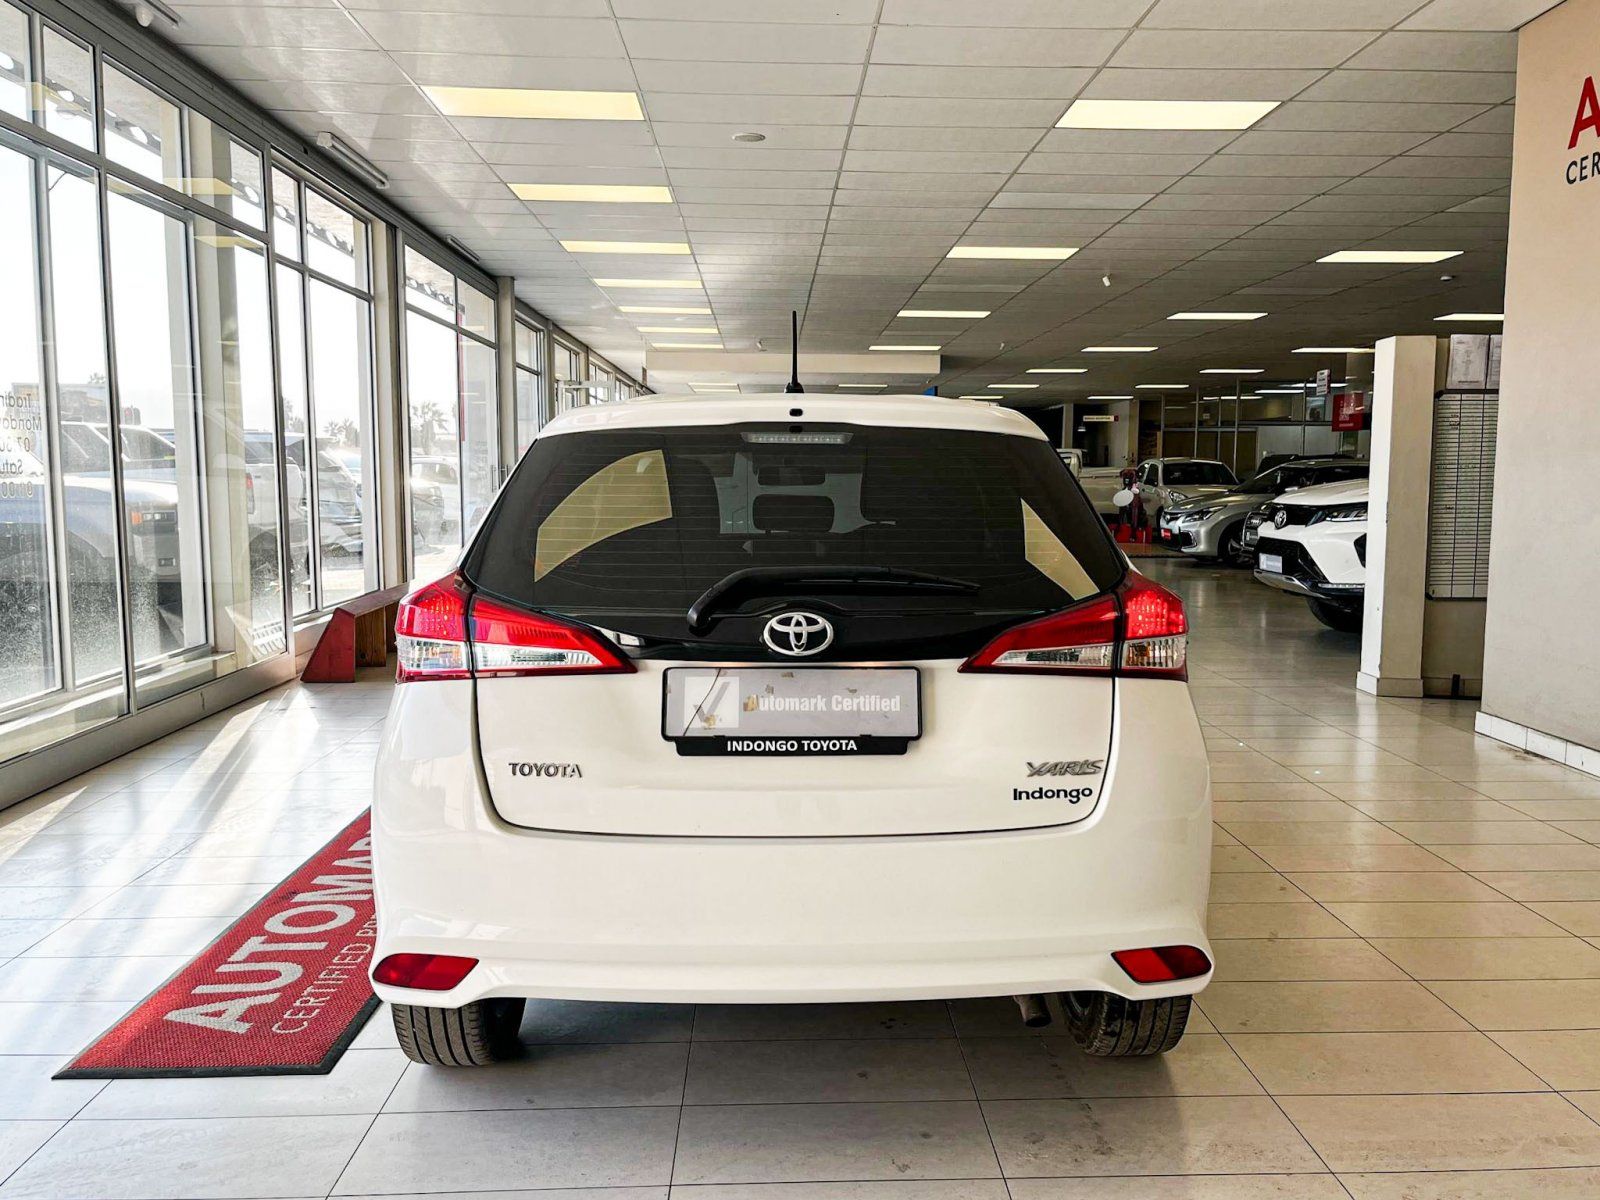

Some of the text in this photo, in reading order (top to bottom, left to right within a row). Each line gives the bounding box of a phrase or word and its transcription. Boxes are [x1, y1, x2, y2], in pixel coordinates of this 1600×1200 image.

[831, 694, 900, 712] Certified
[727, 739, 857, 752] INDONGO TOYOTA
[508, 762, 583, 778] TOYOTA
[1026, 759, 1104, 778] YARIS
[1013, 786, 1093, 804] Indongo
[271, 943, 372, 1034] CERTIFIED
